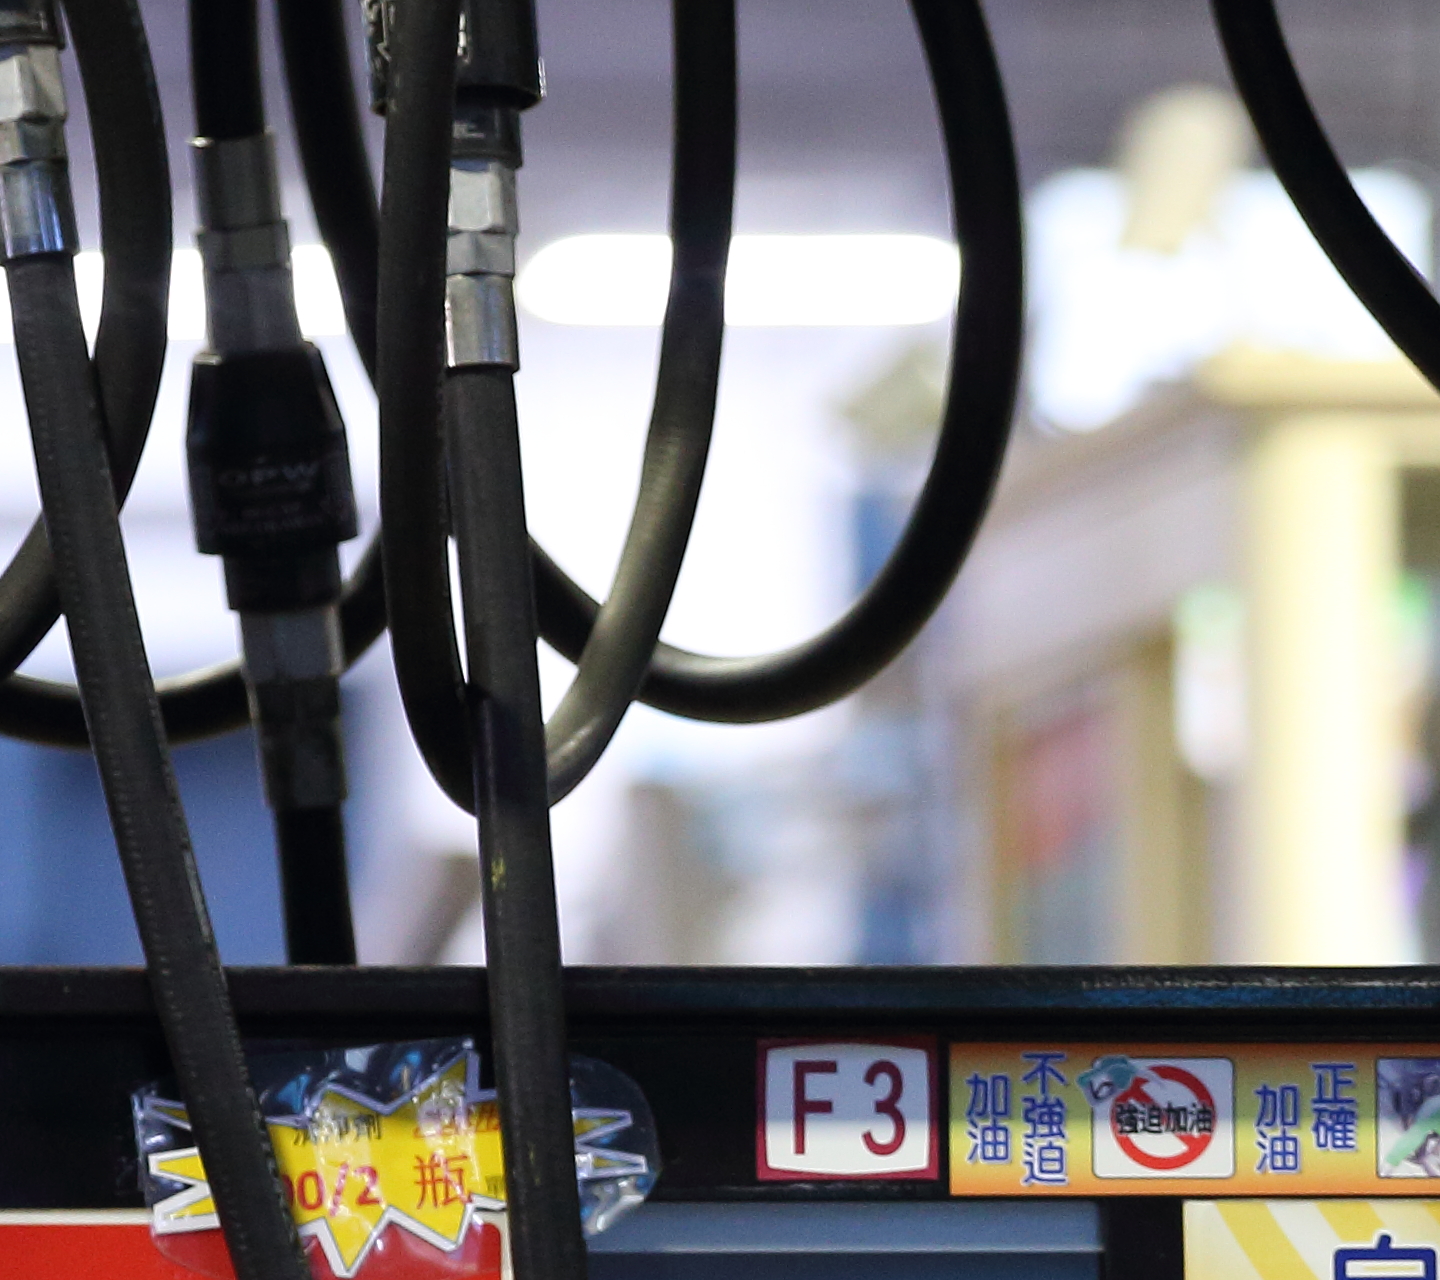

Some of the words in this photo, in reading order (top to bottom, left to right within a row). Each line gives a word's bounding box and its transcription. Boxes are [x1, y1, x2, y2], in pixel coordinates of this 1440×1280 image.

[966, 1073, 1010, 1163] 加油
[1022, 1052, 1067, 1185] 不強迫
[1115, 1102, 1215, 1136] 強迫加油
[1255, 1085, 1299, 1173] 加油
[1310, 1062, 1356, 1151] 正確
